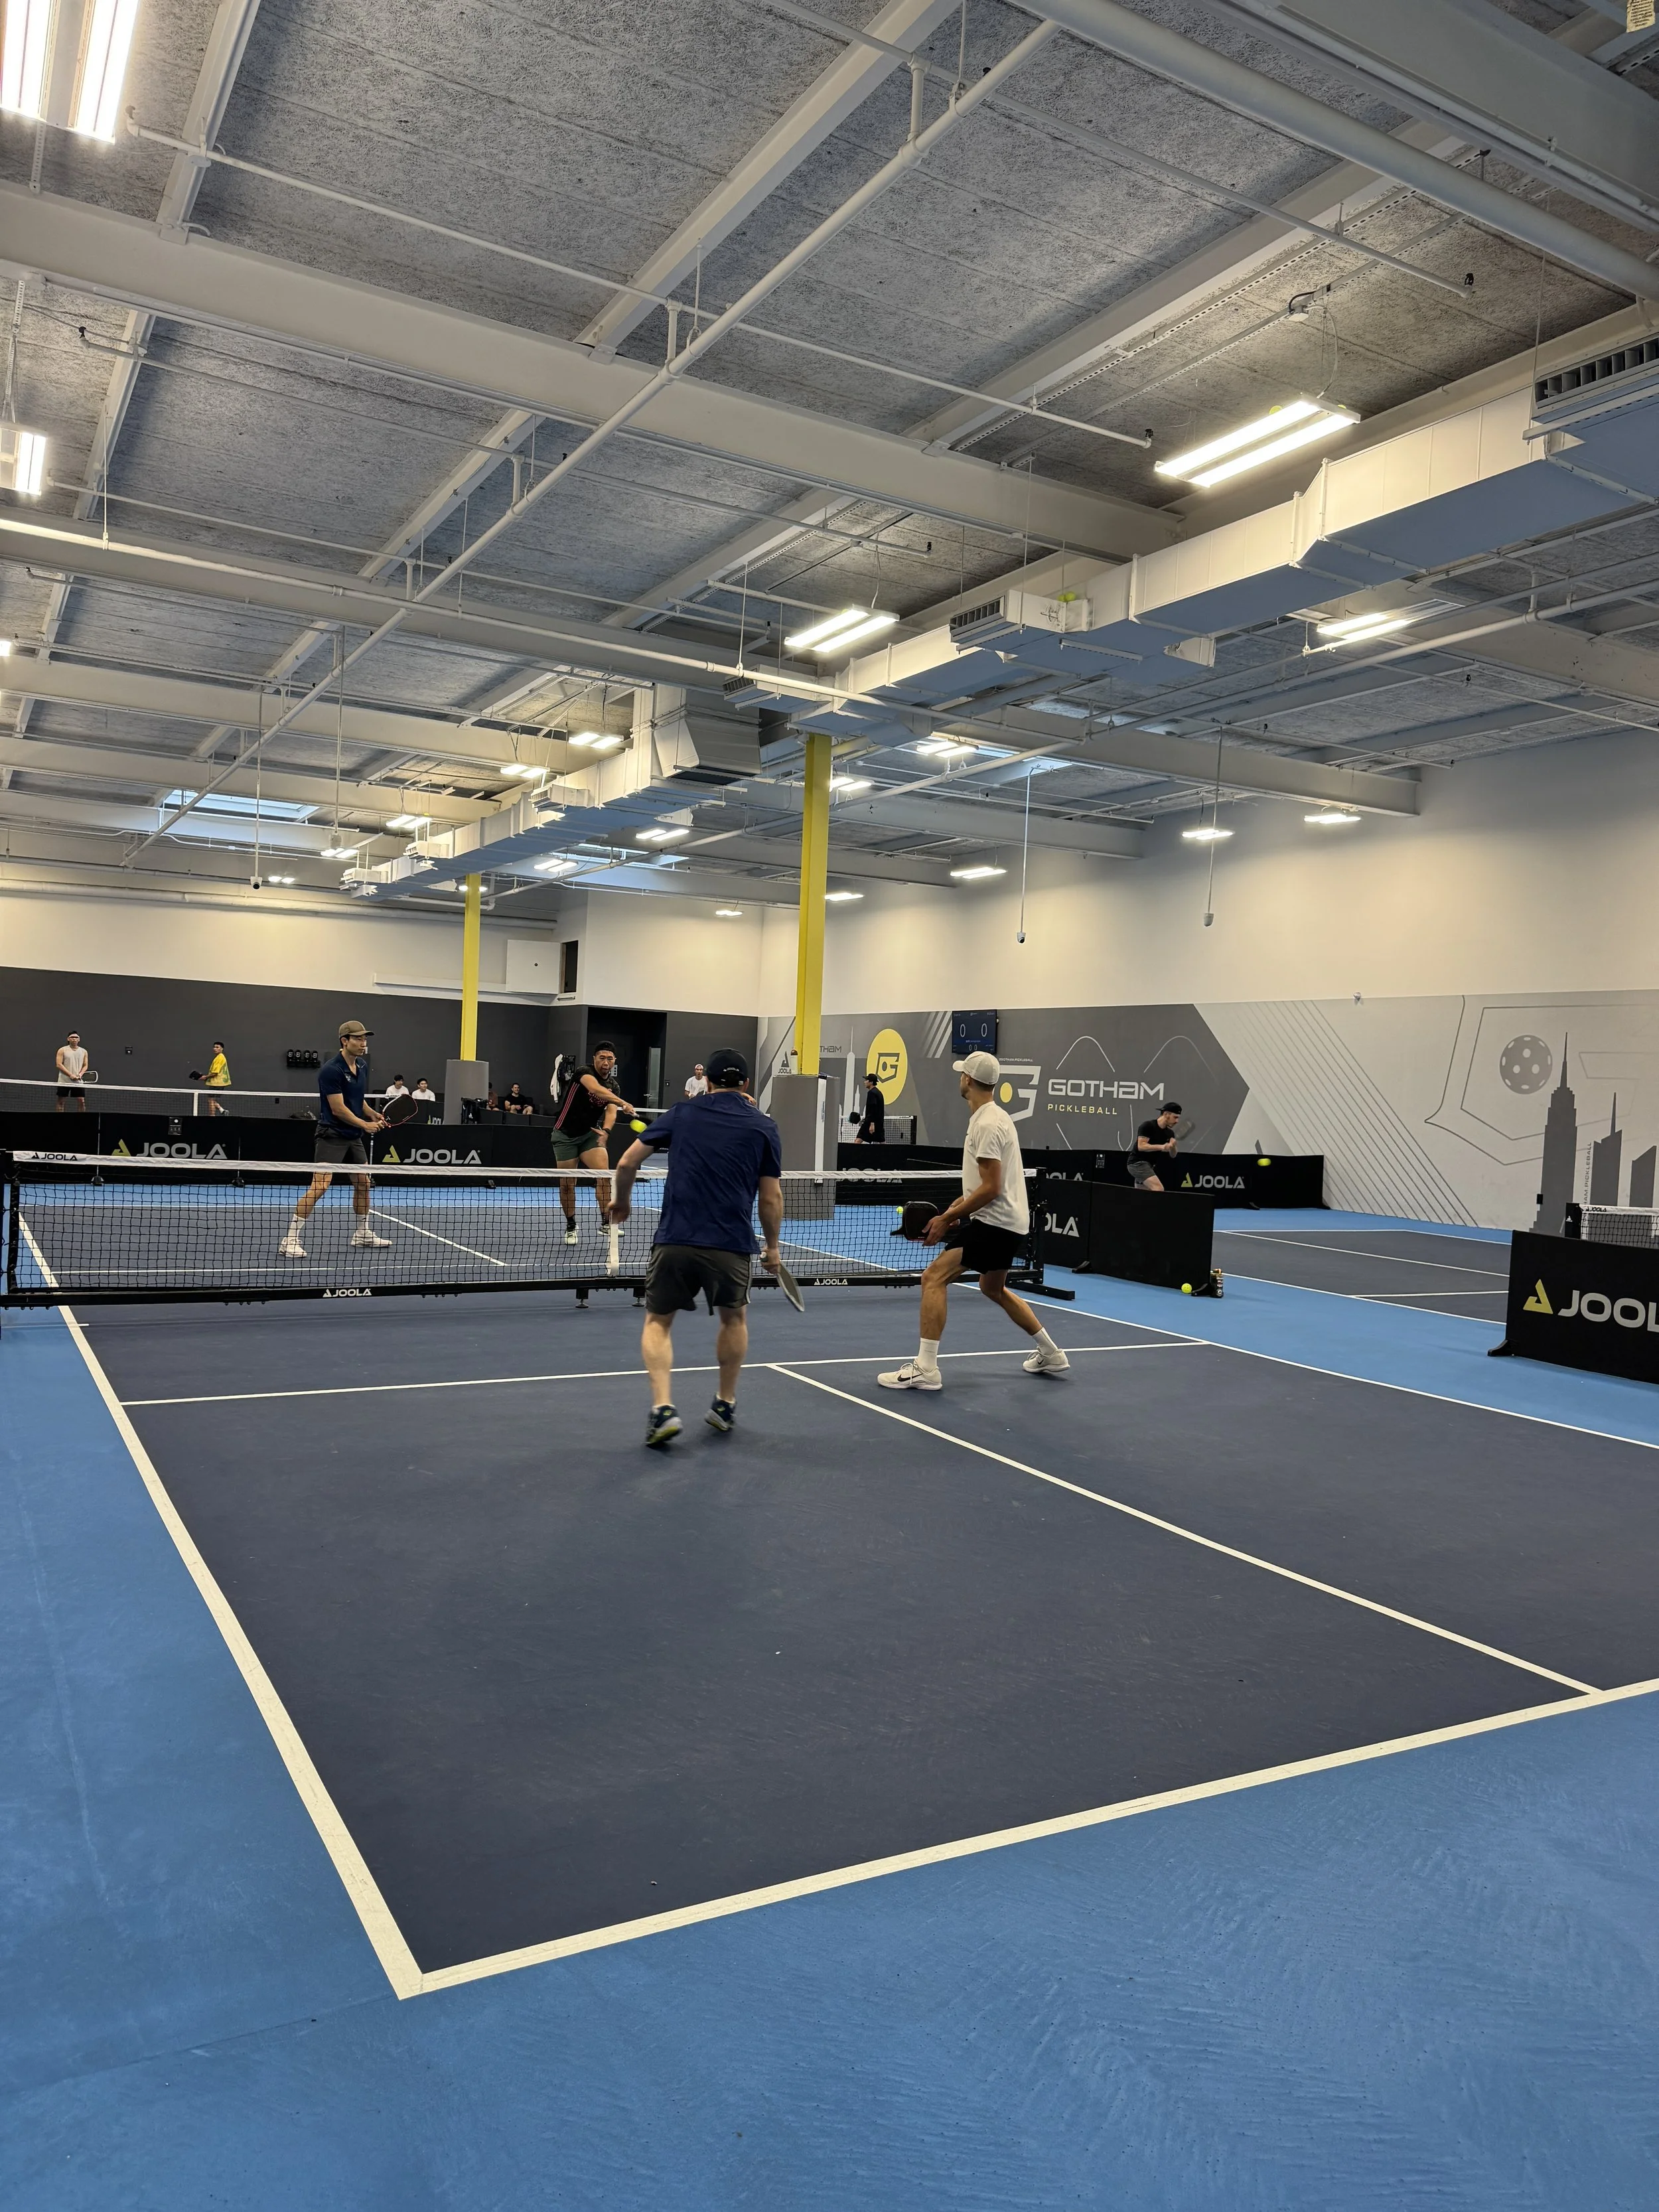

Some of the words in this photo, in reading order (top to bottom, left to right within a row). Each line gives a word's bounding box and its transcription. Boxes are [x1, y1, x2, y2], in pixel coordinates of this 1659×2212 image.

[960, 1023, 966, 1037] 0
[981, 1023, 987, 1037] 0
[1048, 1078, 1165, 1101] GOTHAM
[1047, 1104, 1118, 1115] PICKLEBALL
[41, 1153, 78, 1161] JOOLA
[136, 1142, 228, 1159] JOOLA
[403, 1148, 482, 1164] JOOLA
[1194, 1175, 1245, 1189] JOOLA
[332, 1288, 372, 1297] JOOLA
[1557, 1290, 1659, 1333] JOOL
